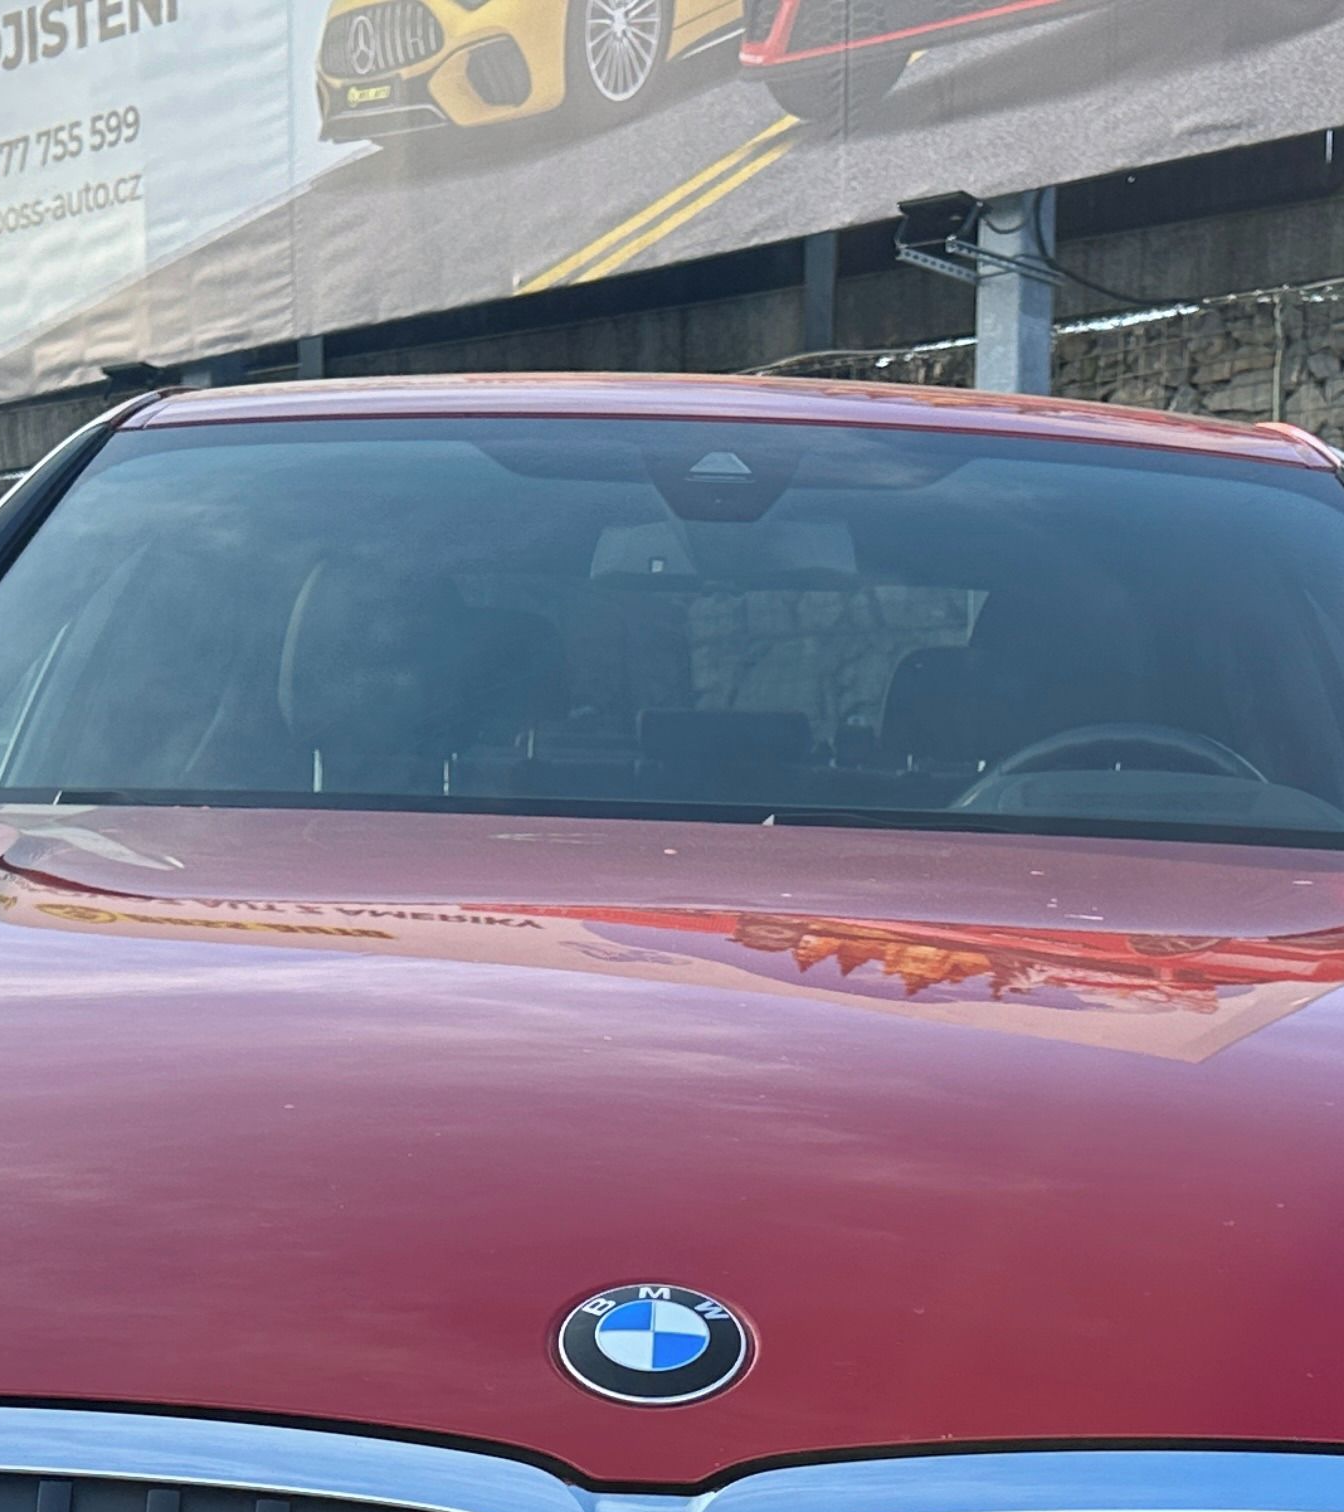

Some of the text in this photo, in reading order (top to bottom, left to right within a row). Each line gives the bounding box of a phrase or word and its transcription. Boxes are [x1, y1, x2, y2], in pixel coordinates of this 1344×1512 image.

[36, 121, 83, 167] 755
[89, 105, 141, 151] 599
[582, 1287, 730, 1320] BMW
